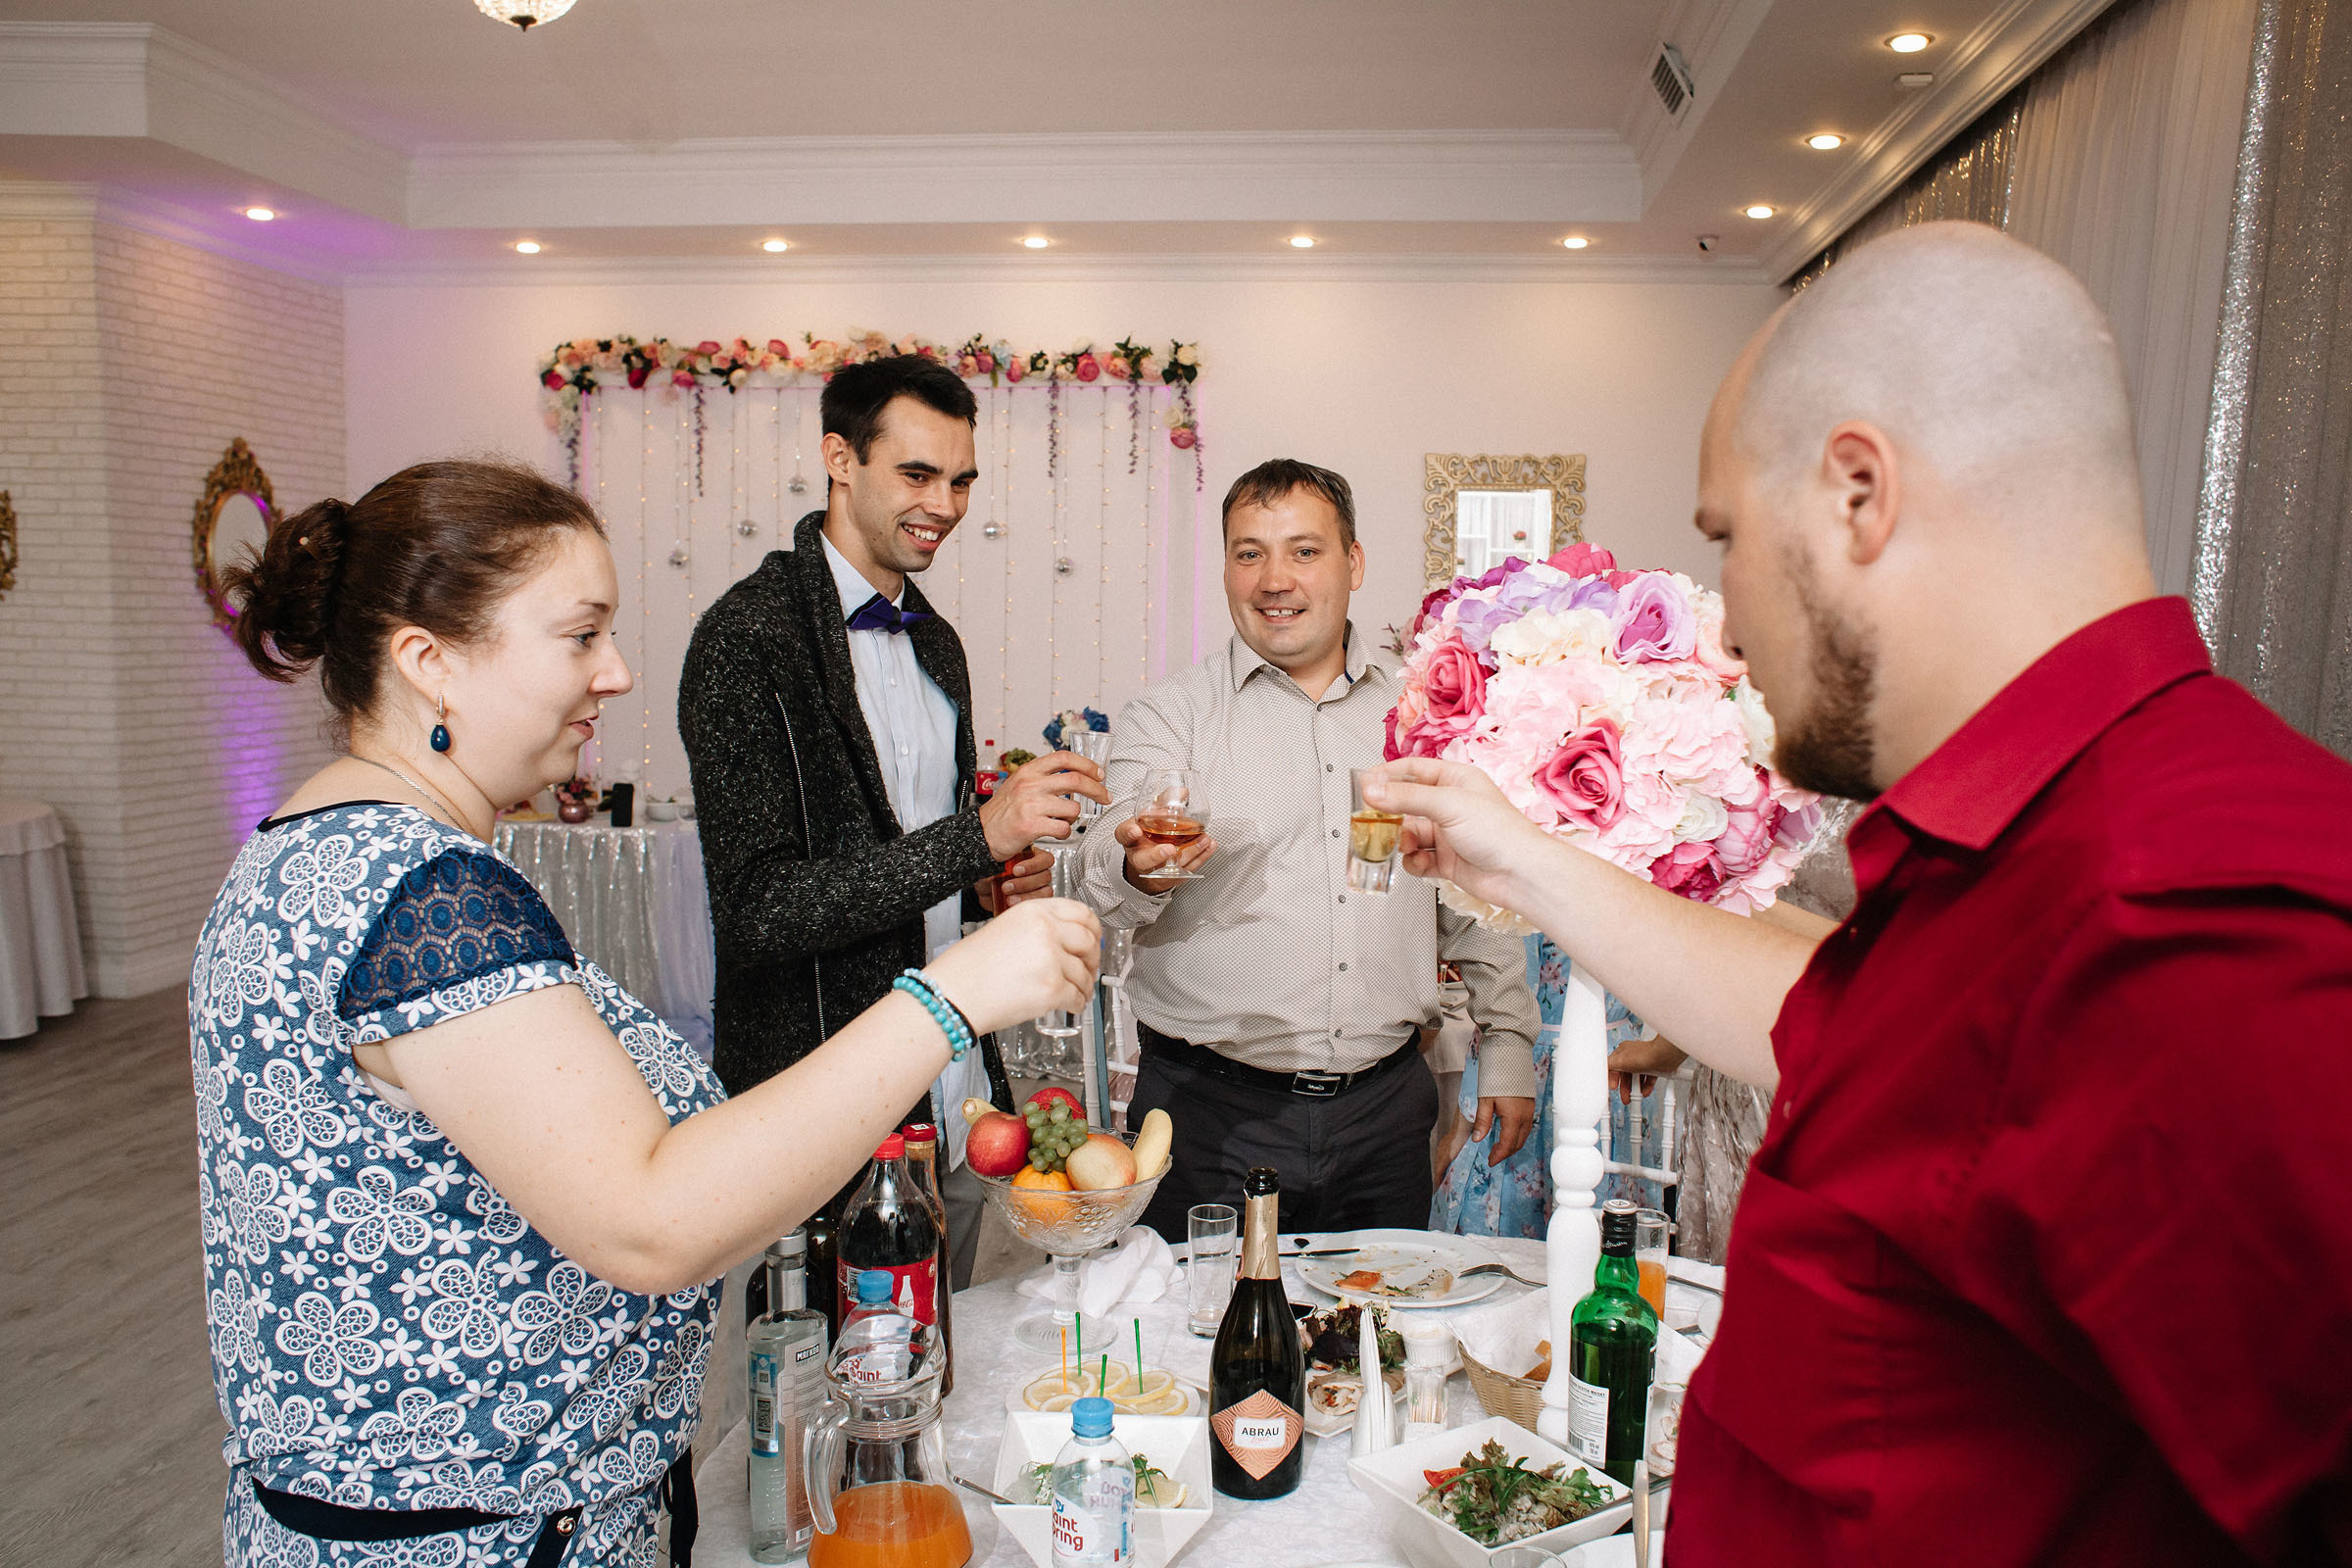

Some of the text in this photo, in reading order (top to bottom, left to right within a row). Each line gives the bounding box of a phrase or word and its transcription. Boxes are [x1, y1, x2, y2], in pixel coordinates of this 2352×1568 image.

[1242, 1427, 1280, 1437] ABRAU
[1053, 1511, 1078, 1533] aint
[1053, 1521, 1084, 1551] pring
